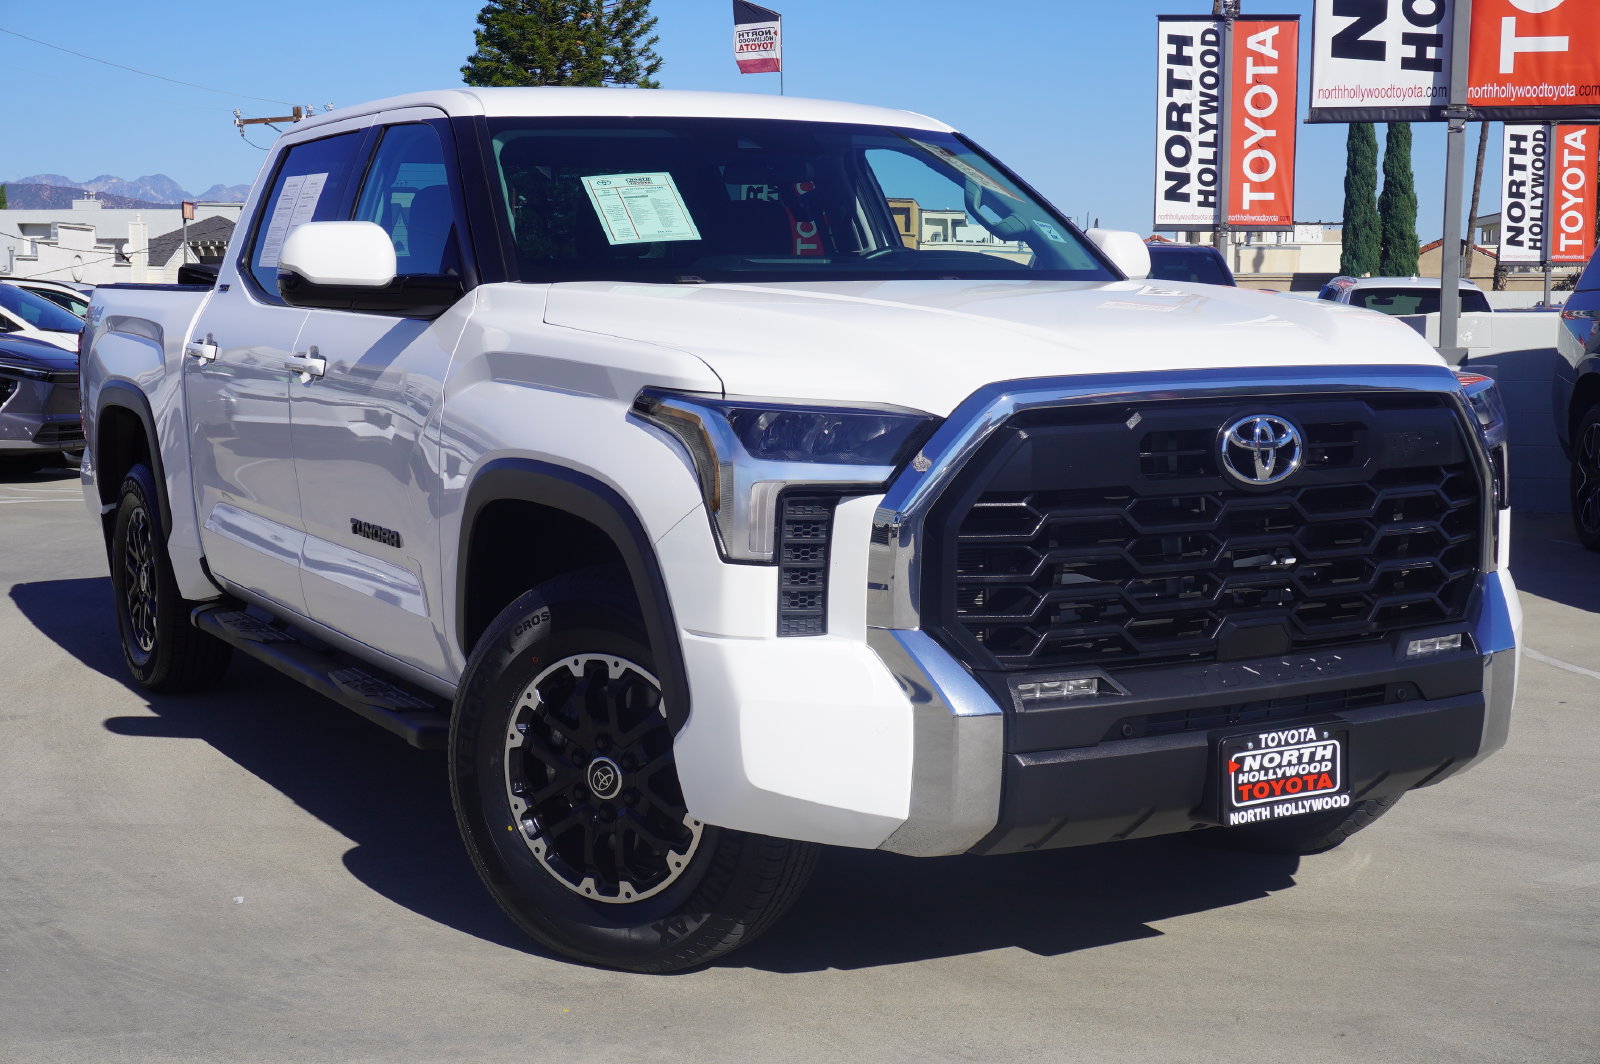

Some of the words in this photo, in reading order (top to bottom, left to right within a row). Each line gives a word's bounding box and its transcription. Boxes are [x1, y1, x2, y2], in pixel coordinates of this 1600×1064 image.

[1318, 84, 1447, 102] northhollywoodtoyota.com
[1164, 33, 1194, 203] NORTH
[1197, 27, 1221, 209] HOLLYWOOD
[1242, 25, 1280, 210] TOYOTA
[1506, 133, 1528, 247] NORTH
[1528, 129, 1547, 251] HOLLYWOOD
[1559, 128, 1587, 252] TOYOTA
[349, 517, 401, 548] TUNDRA
[1258, 727, 1317, 748] TOYOTA
[1238, 761, 1332, 784] HOLLYWOOD
[1243, 745, 1334, 771] NORTH
[1238, 773, 1333, 801] TOYOTA
[1229, 806, 1271, 825] NORTH
[1274, 794, 1350, 818] HOLLYWOOD
